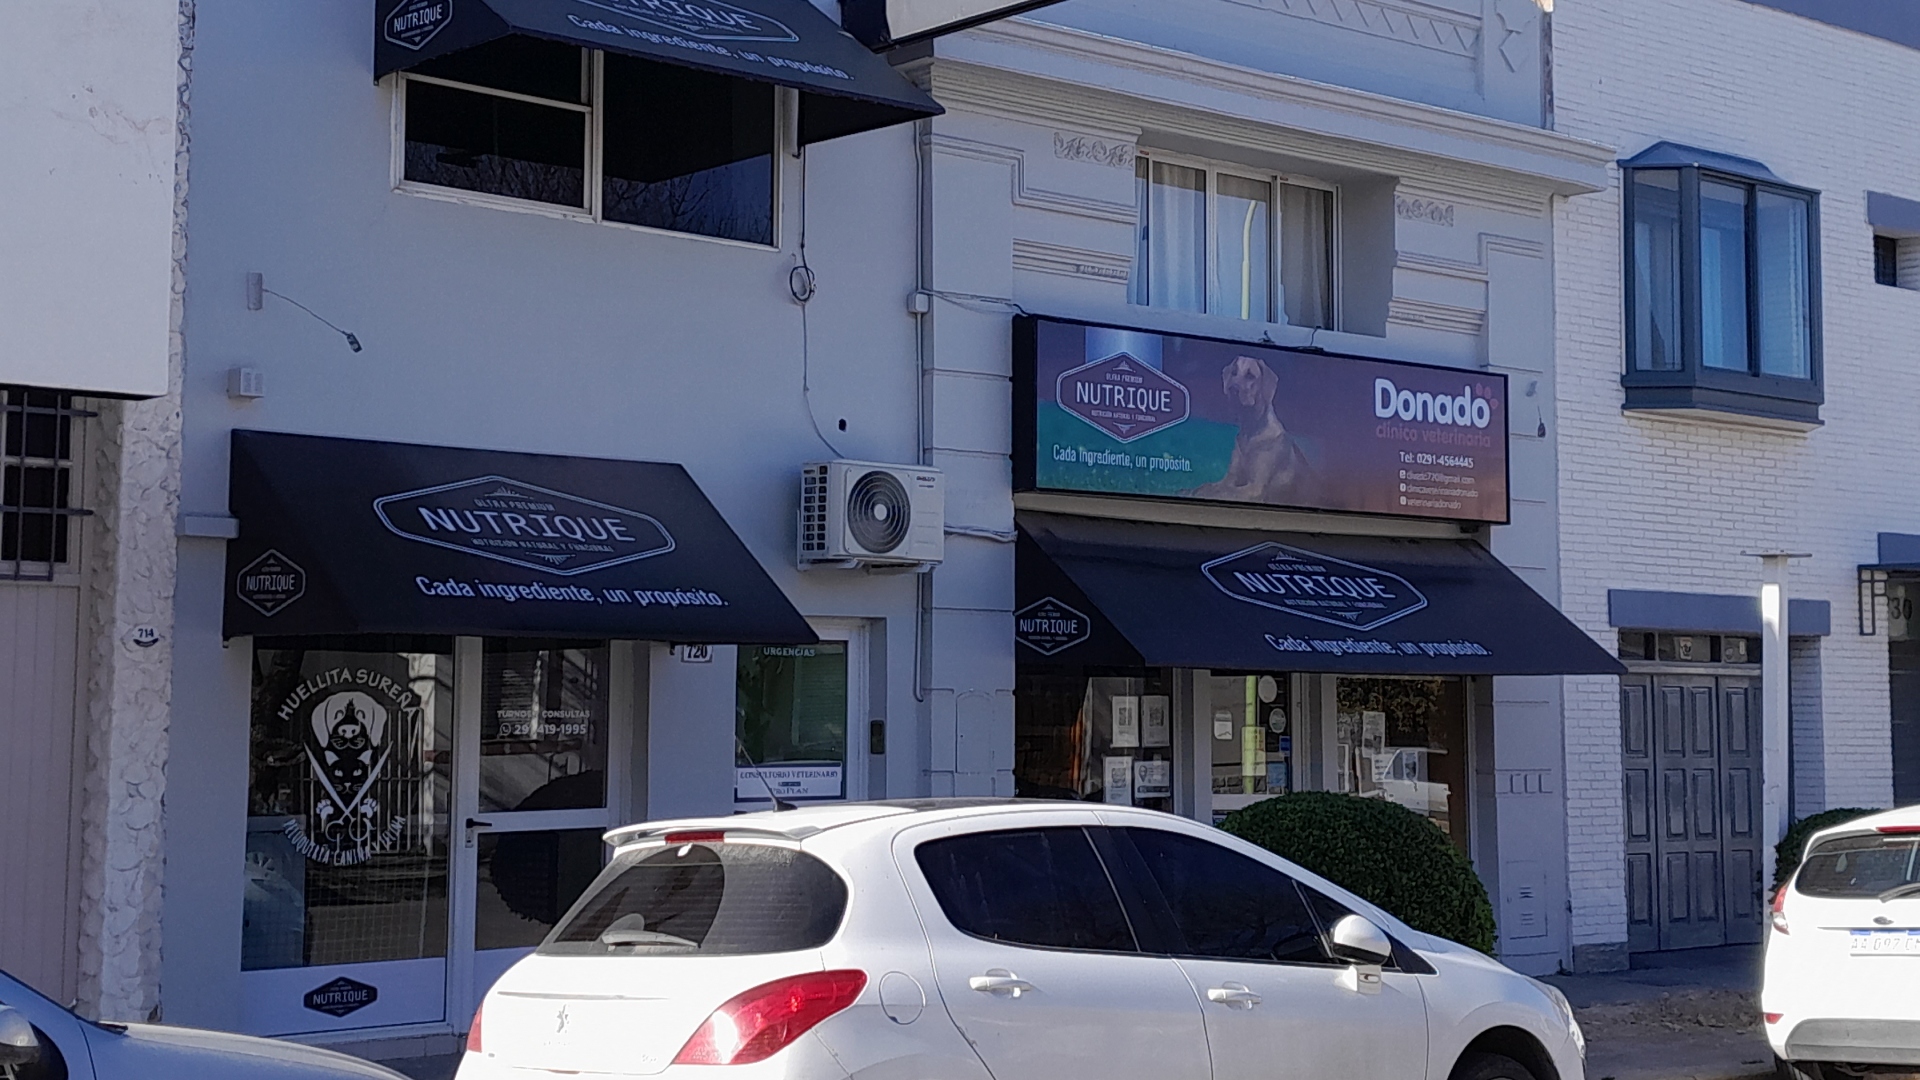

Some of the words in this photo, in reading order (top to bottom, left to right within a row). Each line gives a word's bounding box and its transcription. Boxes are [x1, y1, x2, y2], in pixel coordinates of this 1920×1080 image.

[394, 3, 443, 33] NUTRIQUE
[567, 14, 623, 35] Cada
[622, 25, 738, 59] ingrediente,
[737, 49, 765, 63] un
[767, 54, 855, 81] propósito.
[1076, 381, 1172, 412] NUTRIQUE
[1375, 378, 1490, 429] Donado
[1422, 428, 1491, 449] veterinaria
[1053, 444, 1076, 462] Cada
[1135, 455, 1147, 468] un
[417, 506, 636, 542] NUTRIQUE
[246, 574, 296, 592] NUTRIQUE
[416, 576, 475, 597] Cada
[475, 579, 602, 604] ingrediente,
[603, 587, 632, 603] un
[633, 587, 730, 608] propósito.
[1233, 571, 1396, 600] NUTRIQUE
[138, 628, 154, 638] 714
[1020, 618, 1078, 635] NUTRIQUE
[686, 644, 708, 659] 720
[763, 647, 816, 657] URGENCIAS
[1264, 633, 1311, 652] Cada
[1306, 636, 1402, 656] ingrediente,
[1398, 641, 1422, 654] un
[277, 667, 352, 721] HUELLITA
[355, 669, 419, 721] SUREÑA
[542, 710, 591, 719] CONSULTAS
[312, 989, 369, 1006] NUTRIQUE
